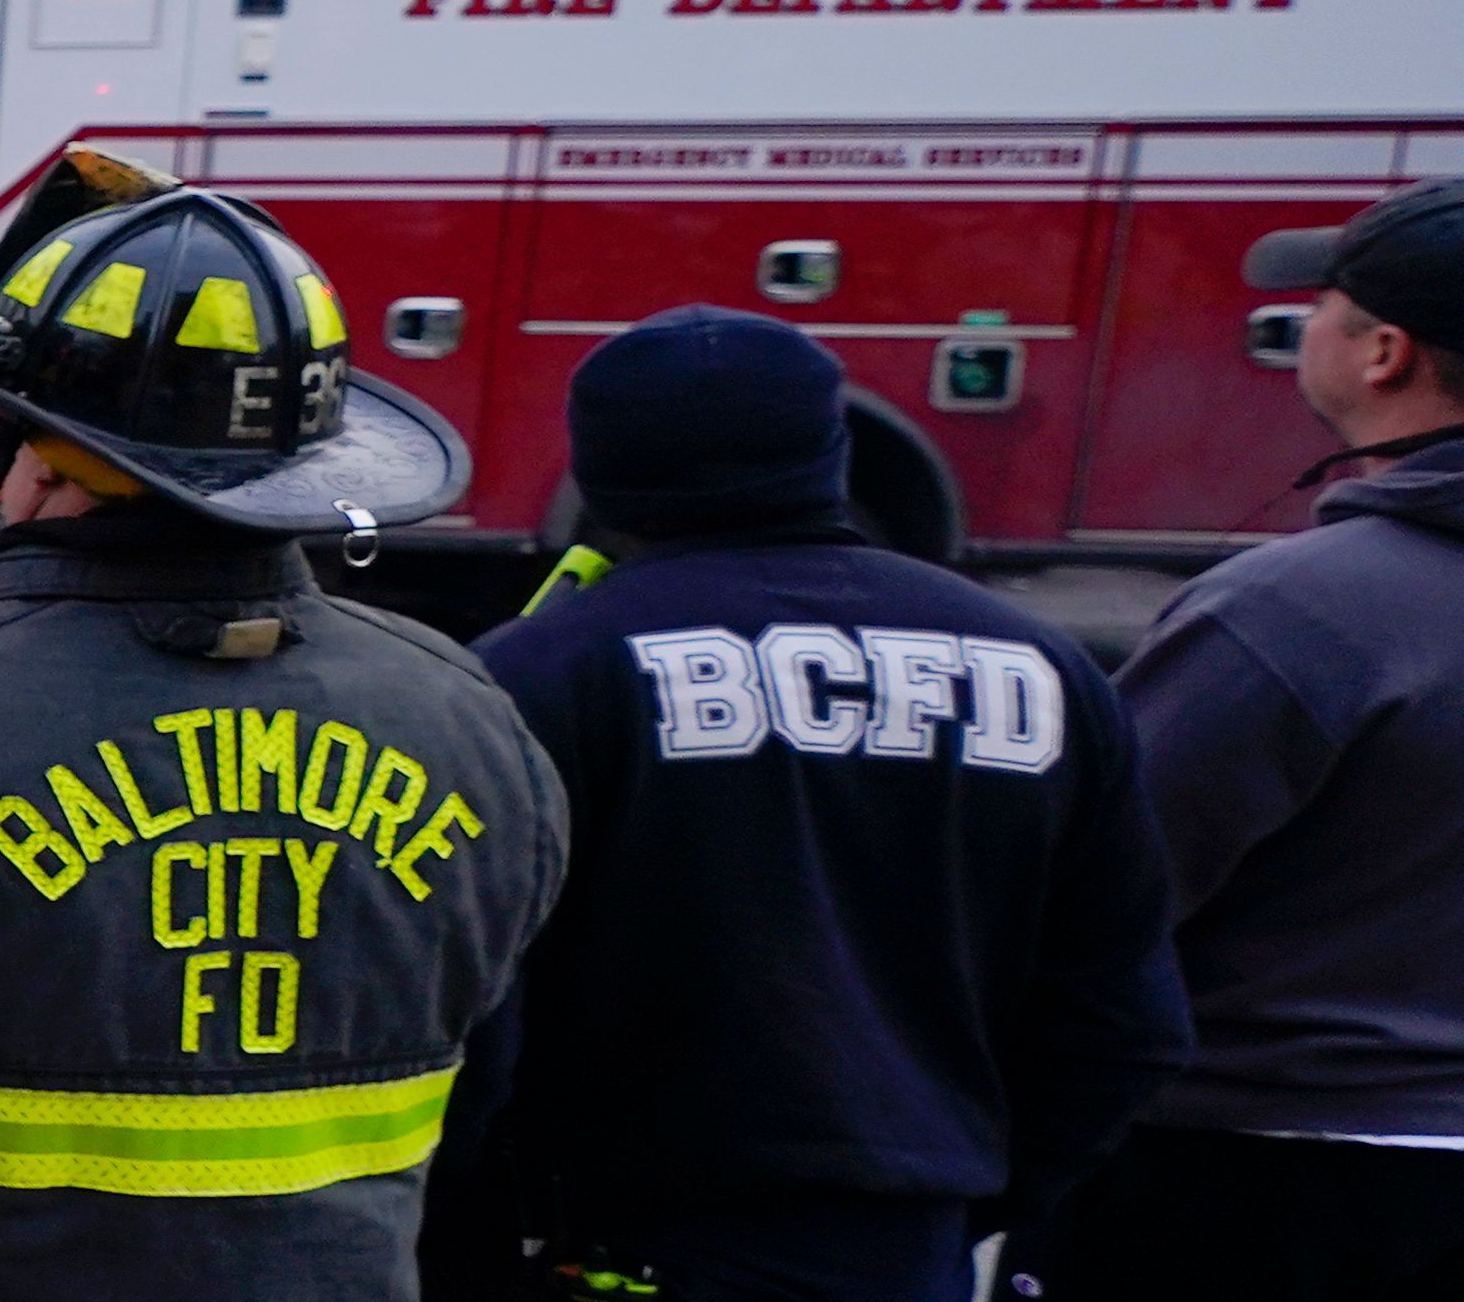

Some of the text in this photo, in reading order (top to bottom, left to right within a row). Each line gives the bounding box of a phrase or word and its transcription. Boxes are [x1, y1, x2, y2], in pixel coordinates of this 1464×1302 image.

[625, 623, 1065, 774] BCFD
[152, 837, 339, 949] CITY
[181, 950, 301, 1054] FD
